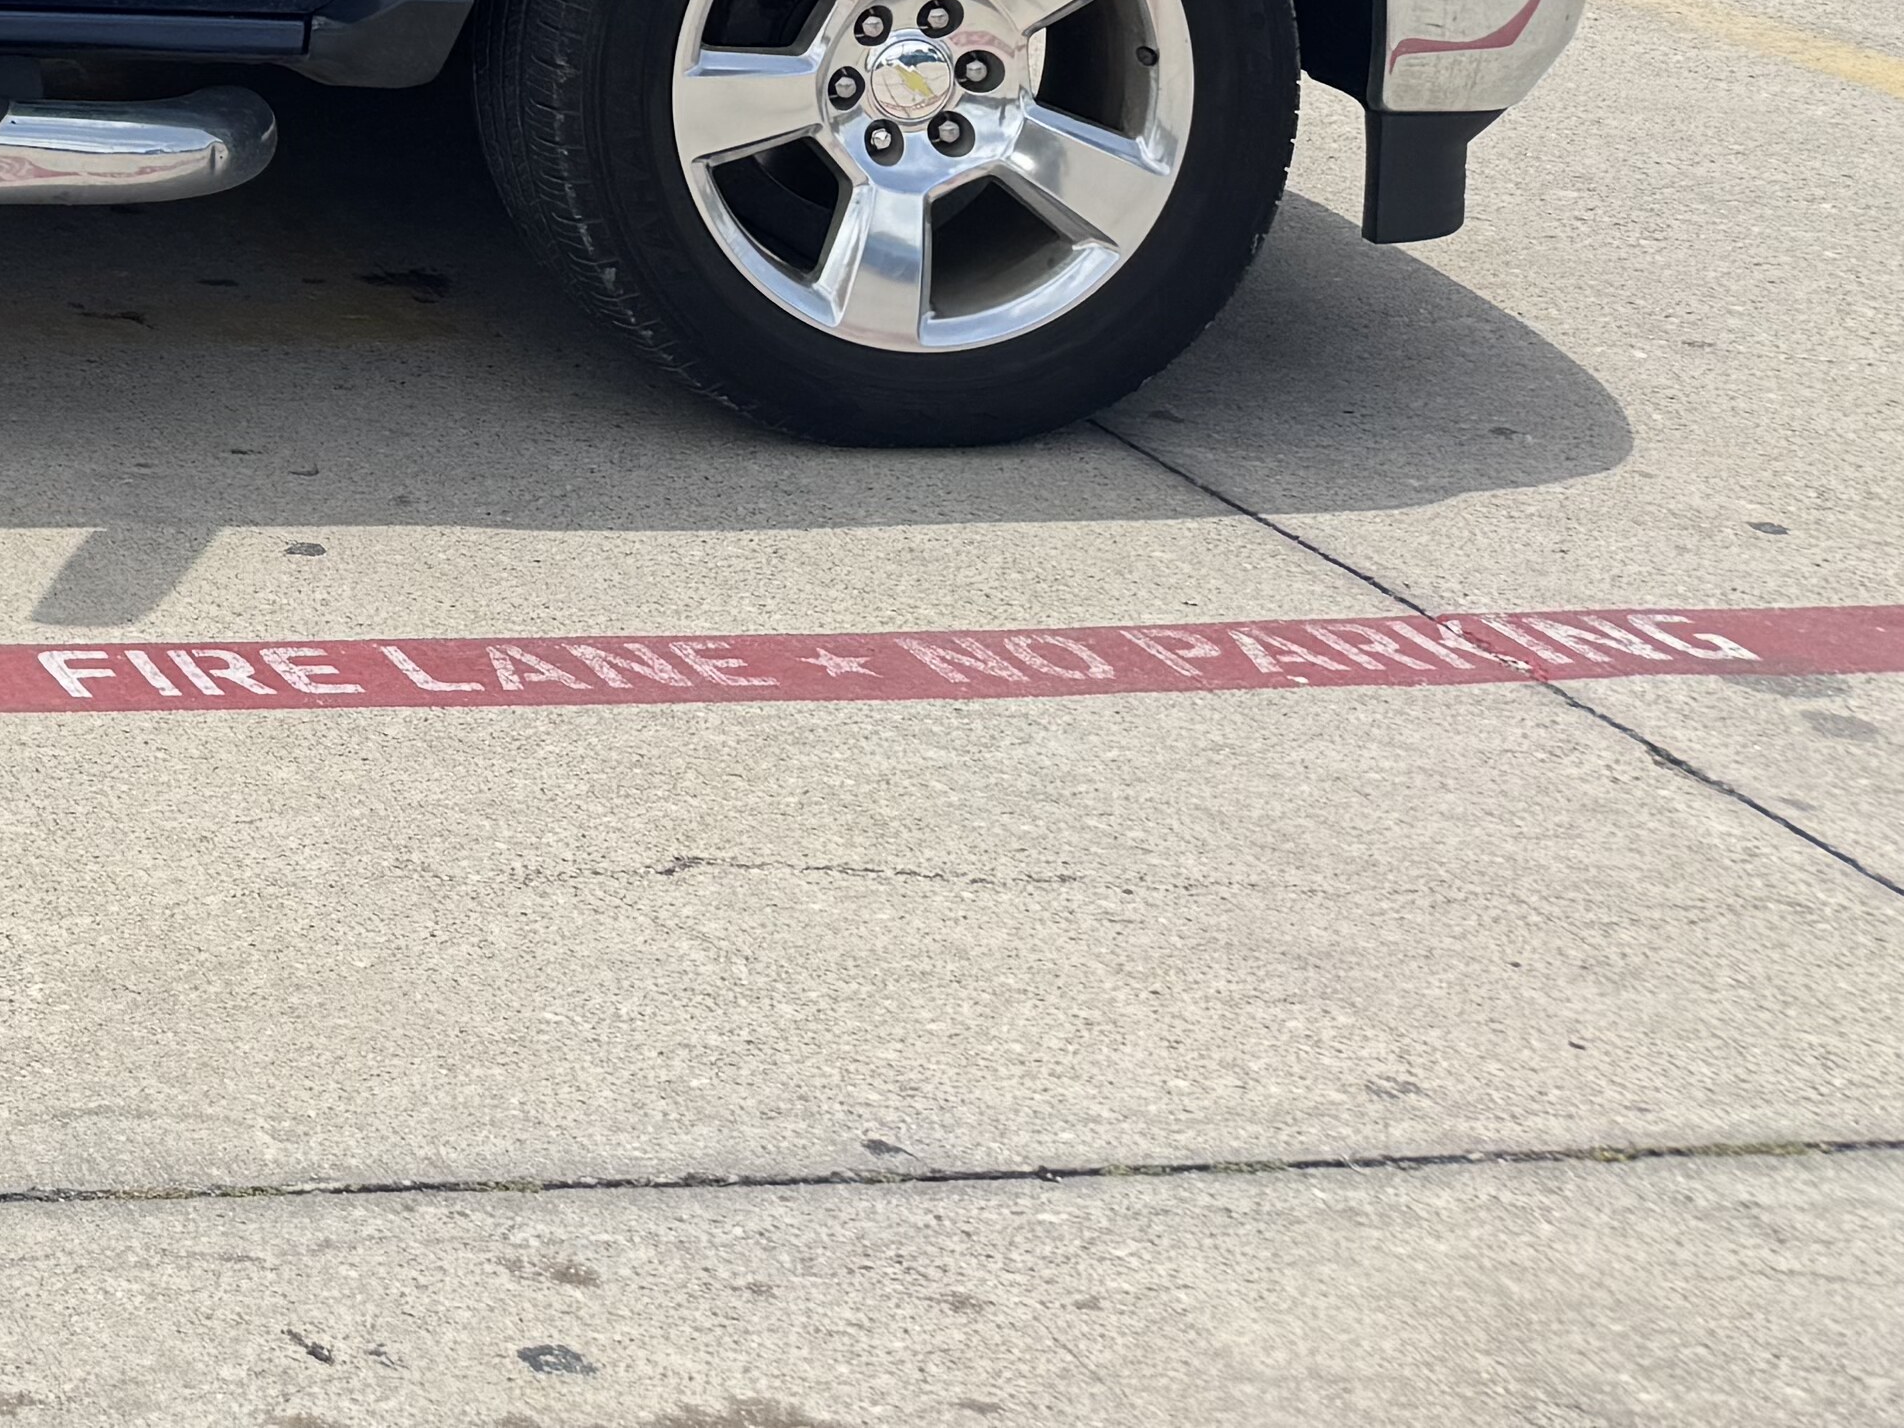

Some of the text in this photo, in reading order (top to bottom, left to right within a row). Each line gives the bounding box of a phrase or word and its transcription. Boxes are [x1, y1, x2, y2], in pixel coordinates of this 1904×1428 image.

[37, 612, 1764, 699] FIRE LANE NO PARKING
